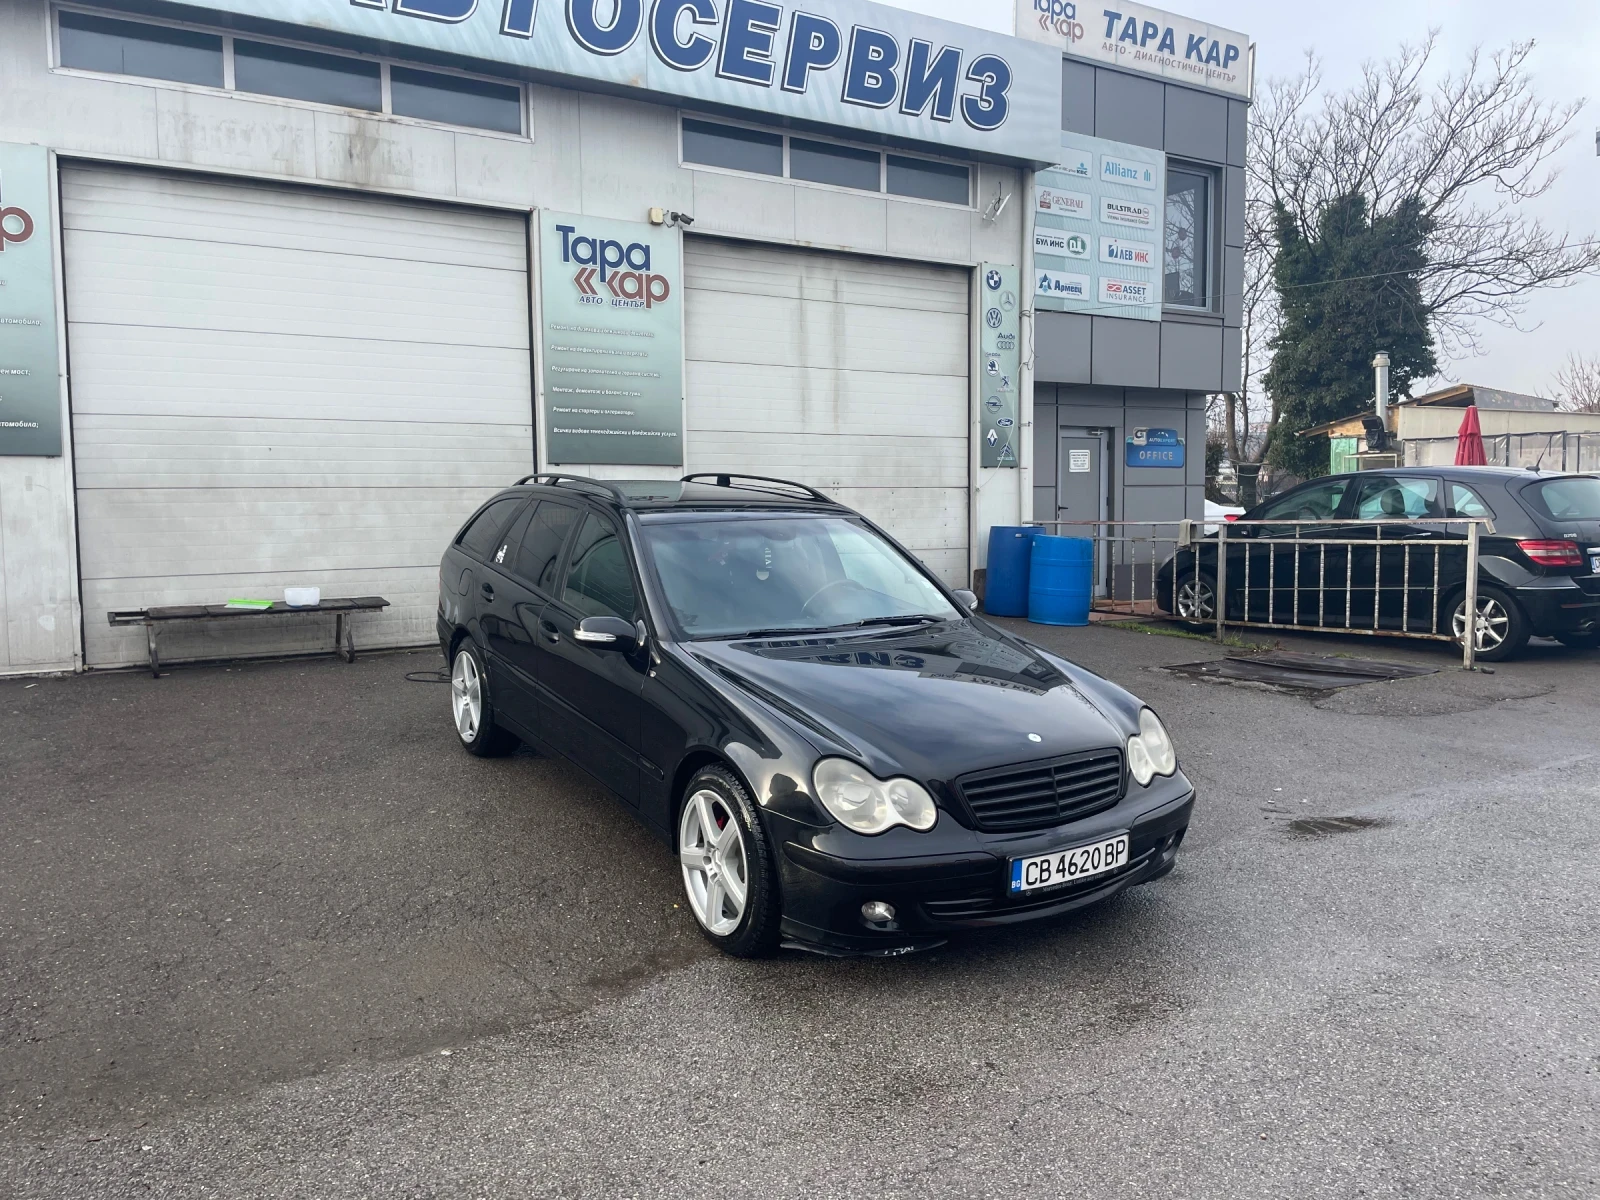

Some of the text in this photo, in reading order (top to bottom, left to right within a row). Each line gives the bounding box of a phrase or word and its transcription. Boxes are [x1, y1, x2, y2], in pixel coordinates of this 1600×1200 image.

[1103, 9, 1239, 69] ТАРА КАР
[349, 0, 1013, 132] ОСЕРВИЗ
[1102, 42, 1126, 55] АВТО
[1134, 50, 1204, 75] ДИАГНОСТИЧЕН
[1206, 67, 1236, 82] ЦЕНТЪР
[1104, 161, 1138, 179] Allianz
[1107, 203, 1142, 215] BULSTRAD
[1036, 237, 1048, 246] БУЛ
[1050, 239, 1064, 248] ИНС
[555, 224, 651, 283] Тара
[1120, 249, 1133, 260] ЛЕВ
[1134, 250, 1149, 263] ИНС
[1122, 286, 1146, 296] ASSET
[579, 295, 604, 305] АВТО
[611, 298, 645, 308] ЦЕНТЪР
[1106, 293, 1147, 303] INSURANCE
[11, 368, 31, 376] мост;
[0, 420, 39, 429] томобила;
[1139, 450, 1173, 461] OFFICE
[1025, 838, 1126, 887] CB 4620 BP
[1011, 879, 1021, 889] BG
